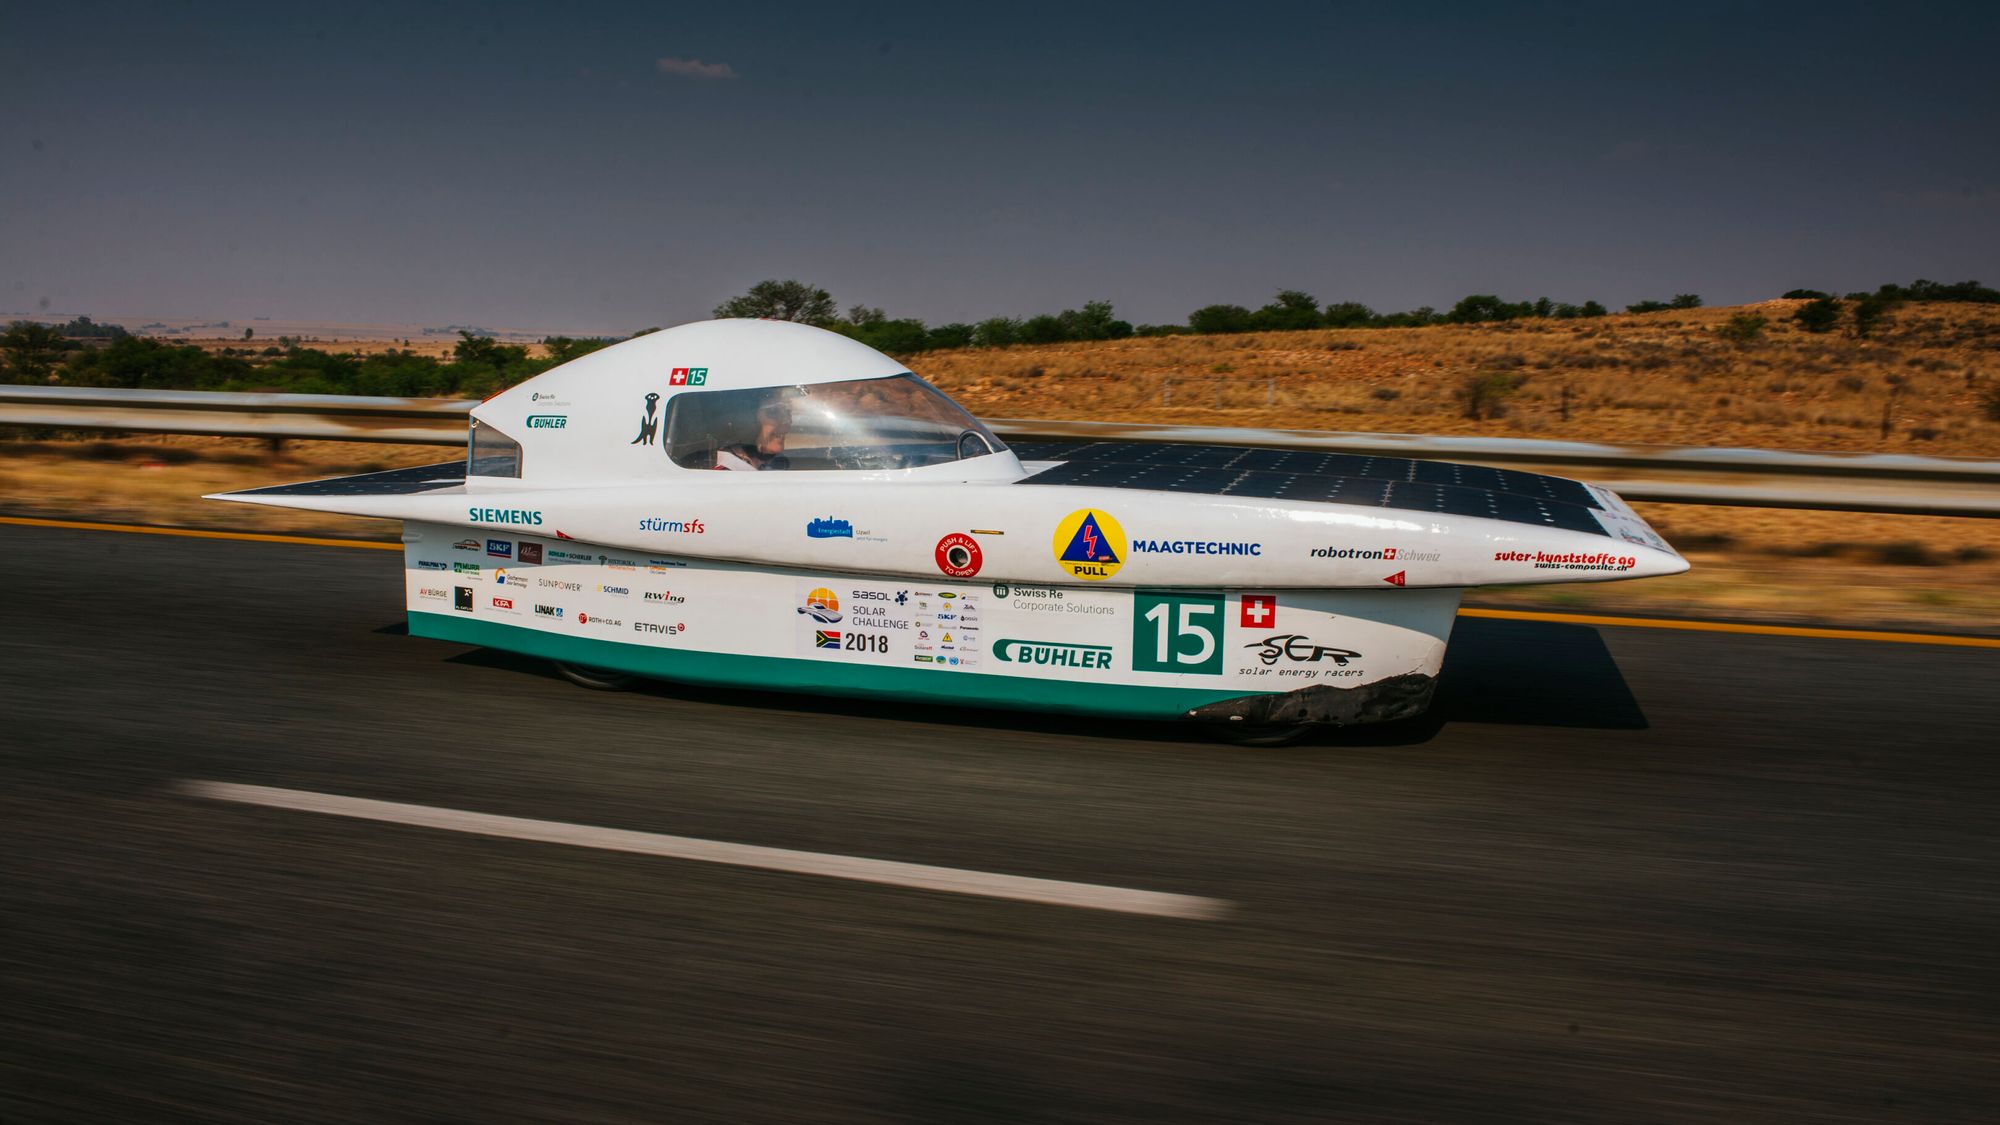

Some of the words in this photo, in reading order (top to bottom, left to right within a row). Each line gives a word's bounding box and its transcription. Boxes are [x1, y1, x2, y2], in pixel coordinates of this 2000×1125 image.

[690, 370, 706, 384] 15
[469, 508, 543, 525] SIEMENS
[639, 518, 704, 534] stürmsfs
[489, 542, 510, 552] SKF
[940, 537, 957, 552] PUSH
[964, 540, 977, 554] LIFT
[1133, 540, 1261, 556] MAAGTECHNIC
[1310, 547, 1382, 560] robotron
[1396, 549, 1441, 562] Schweiz
[1495, 551, 1615, 565] suter-kunststoffe
[1617, 557, 1636, 568] ag
[945, 566, 954, 574] TO
[955, 567, 974, 576] OPEN
[1074, 566, 1108, 576] PULL
[1534, 562, 1628, 571] swiss-composite.ch
[539, 578, 581, 592] SUNPOWER
[603, 585, 629, 595] SCHMID
[644, 591, 685, 603] RWing
[1014, 587, 1047, 598] Swiss
[1049, 589, 1064, 599] Re
[535, 604, 555, 616] LINAK
[853, 605, 886, 616] SOLAR
[1013, 600, 1064, 613] Corporate
[1066, 602, 1115, 615] Solutions
[634, 622, 677, 635] ETAVIS
[852, 617, 909, 629] CHALLENGE
[1144, 603, 1216, 665] 15
[845, 633, 888, 653] 2018
[1018, 647, 1113, 669] BÜHLER
[1279, 669, 1318, 678] energy
[1325, 669, 1364, 677] racers
